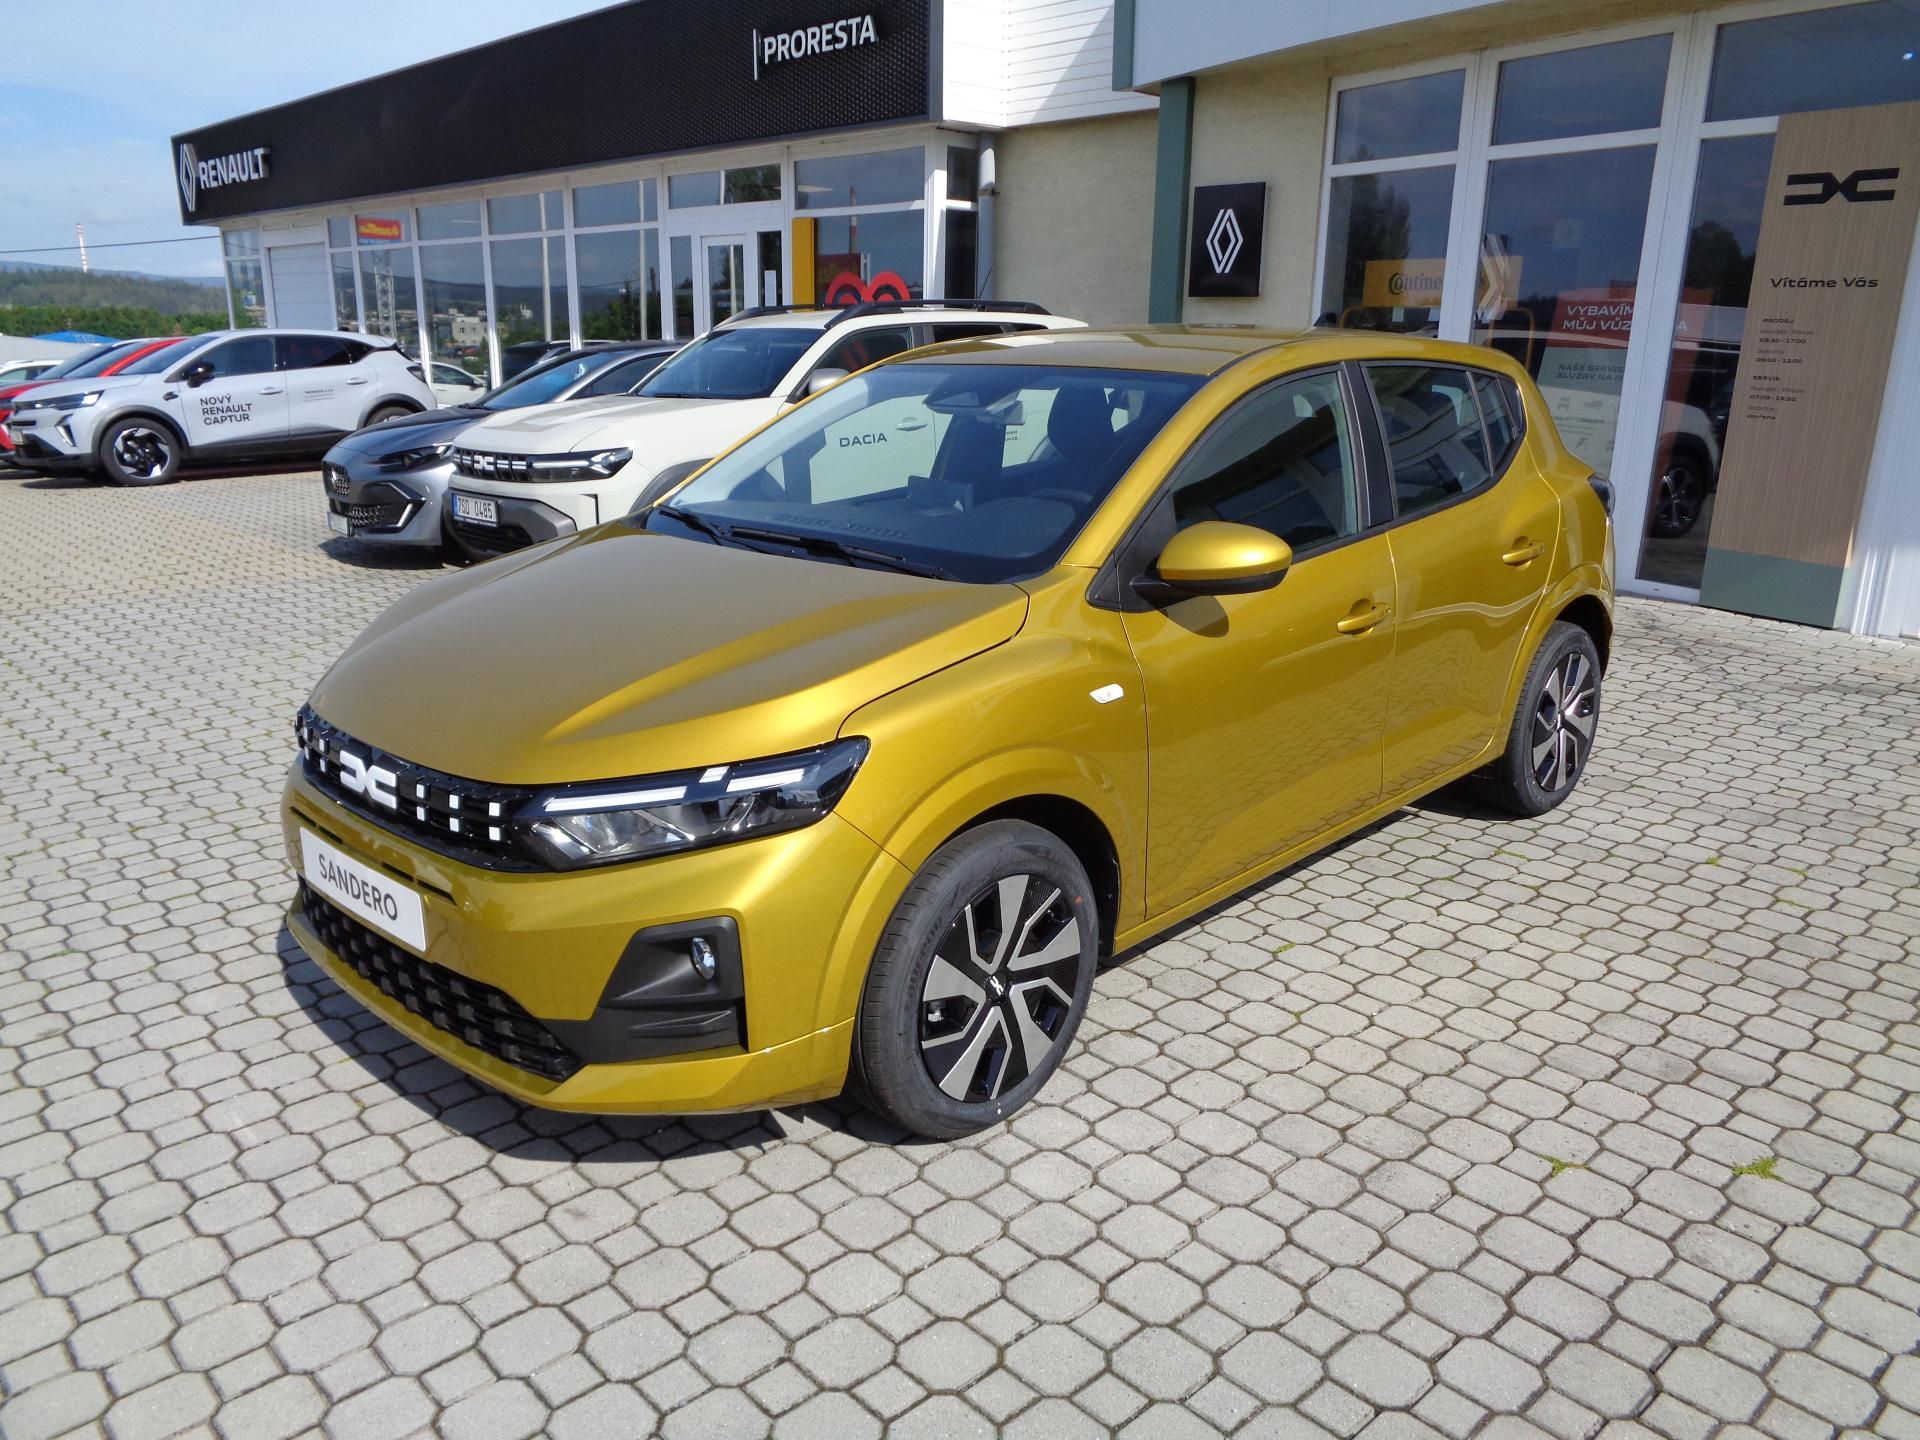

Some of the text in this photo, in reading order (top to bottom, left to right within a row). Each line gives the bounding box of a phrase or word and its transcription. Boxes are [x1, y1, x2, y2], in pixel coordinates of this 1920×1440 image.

[763, 14, 877, 65] PRORESTA
[198, 147, 268, 190] RENAULT
[1770, 276, 1880, 288] Vítáme Vás
[1562, 316, 1597, 331] MŮJ
[200, 393, 232, 406] NOVÝ
[202, 403, 253, 416] RENAULT
[203, 413, 250, 425] CAPTUR
[839, 432, 888, 448] DACIA
[318, 853, 398, 921] SANDERO
